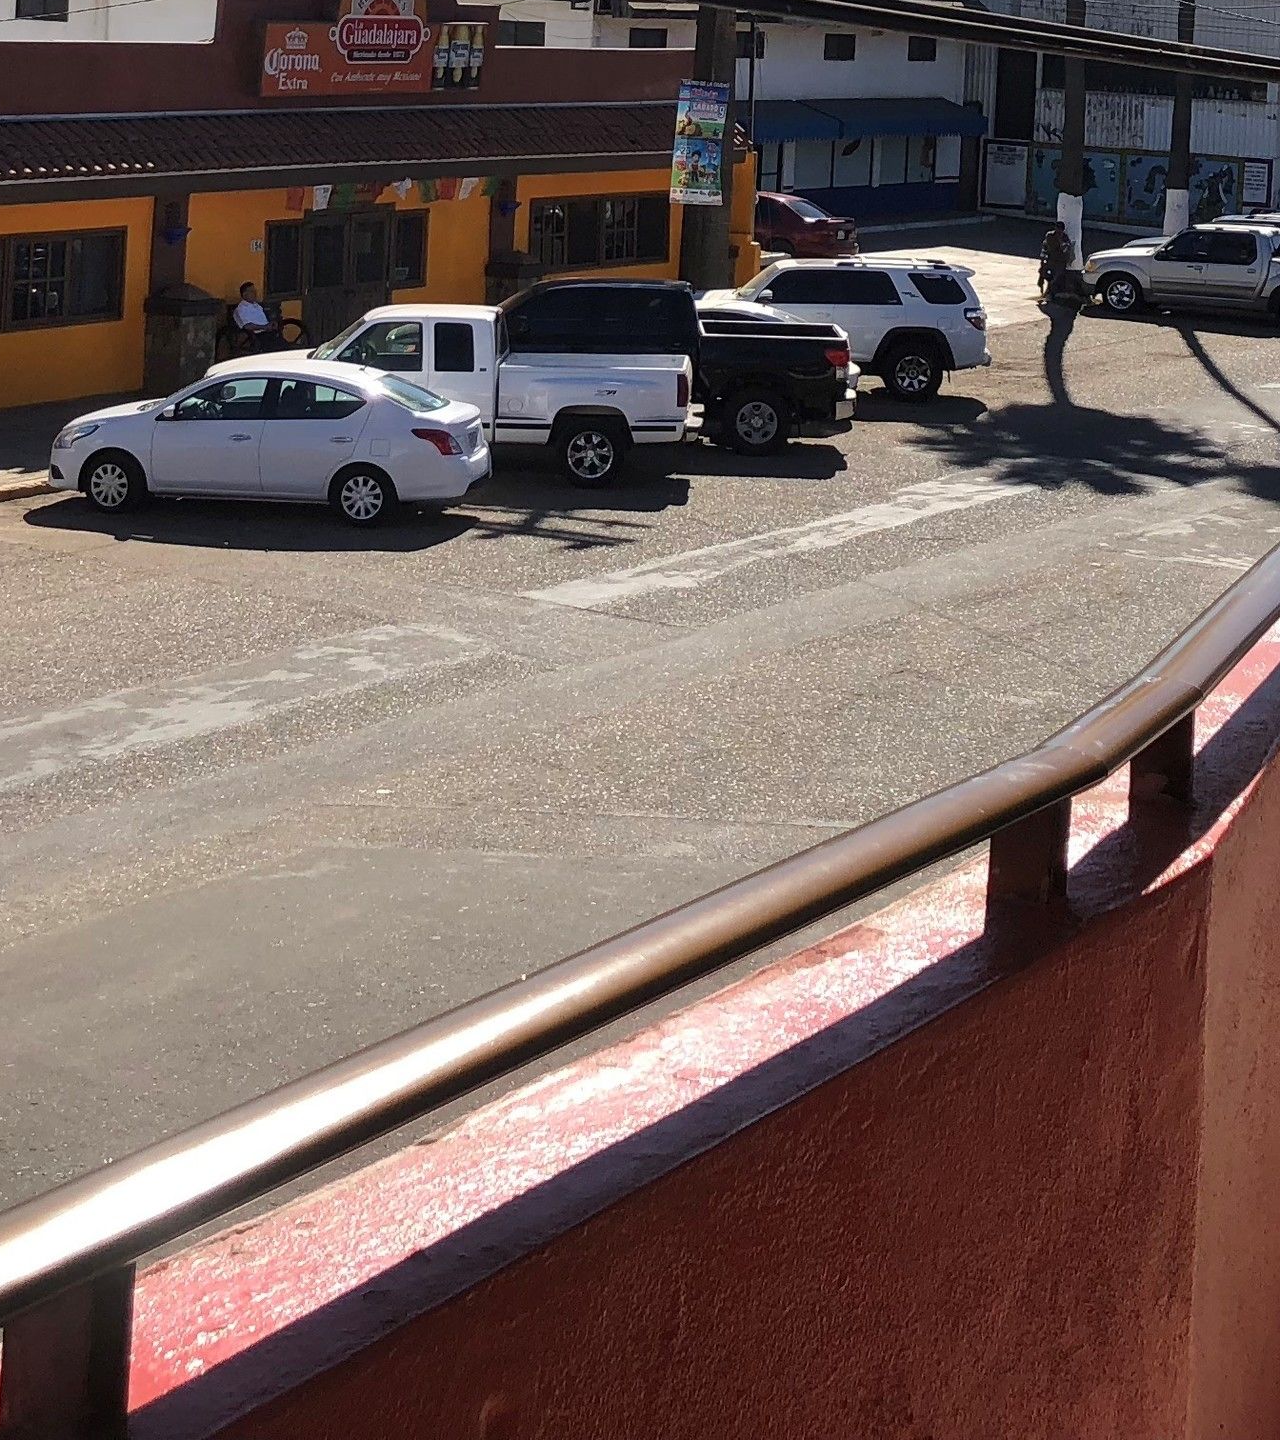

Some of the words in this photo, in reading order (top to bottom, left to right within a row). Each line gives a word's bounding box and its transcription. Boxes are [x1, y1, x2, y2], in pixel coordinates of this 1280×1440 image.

[343, 22, 417, 49] Guadalajara
[264, 48, 320, 78] Corona
[278, 73, 308, 90] Extra
